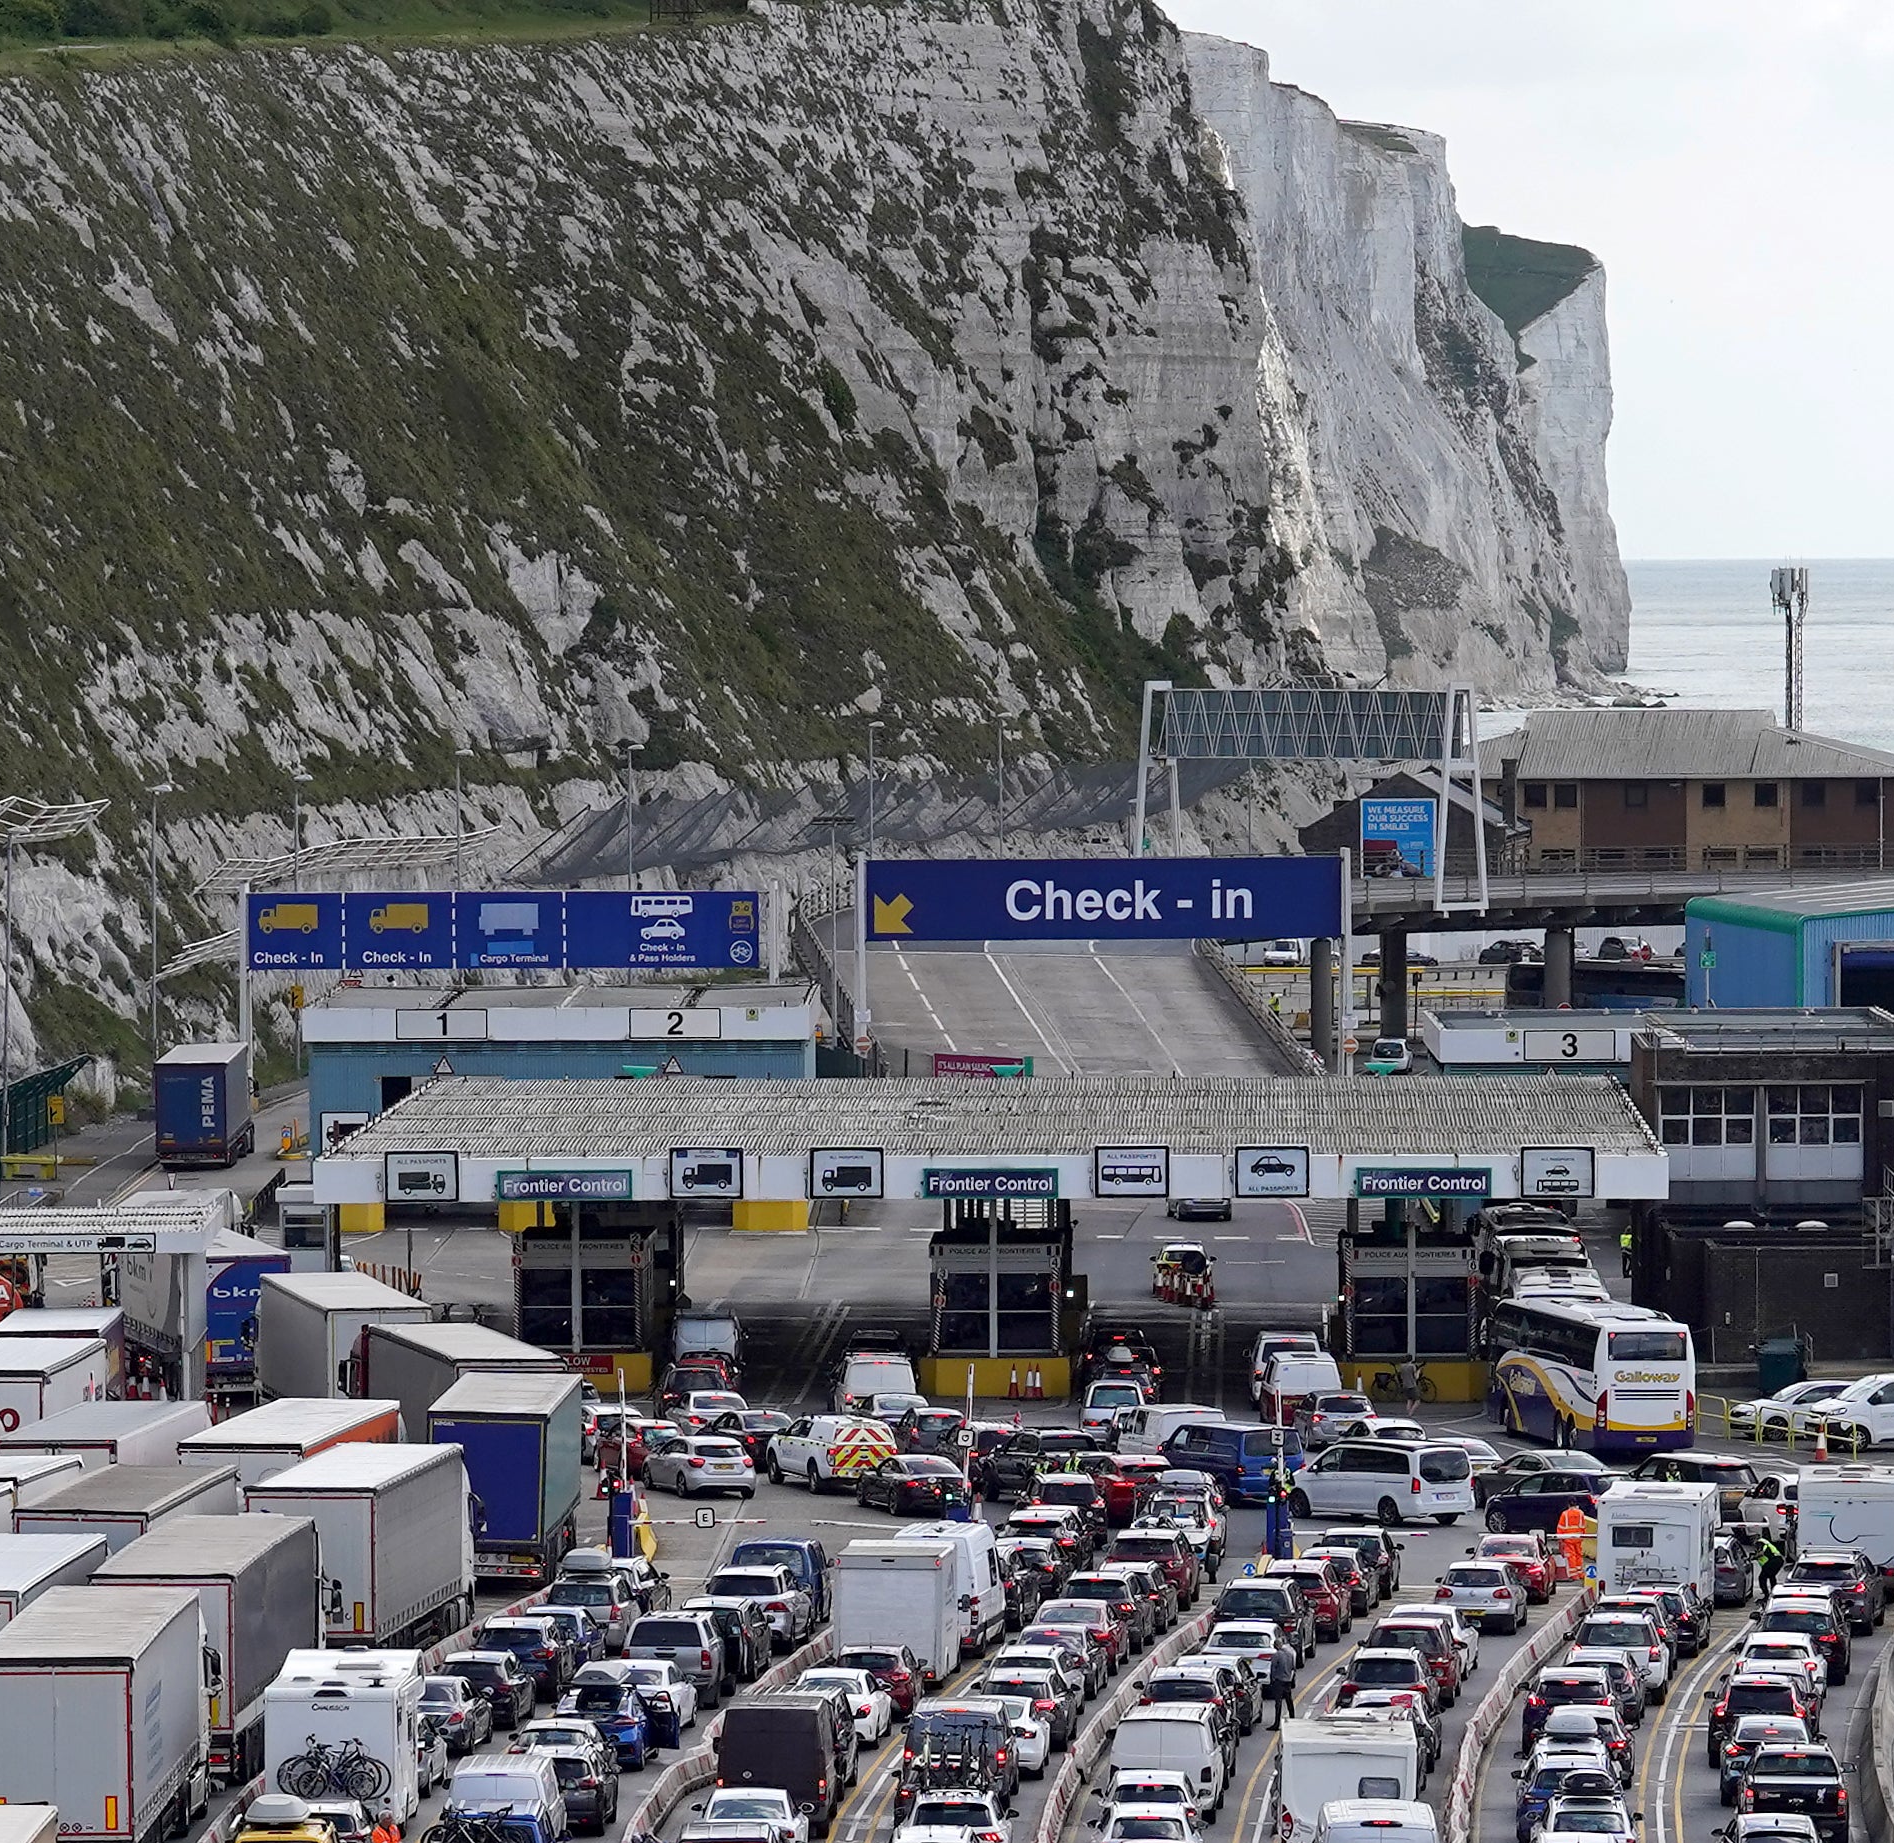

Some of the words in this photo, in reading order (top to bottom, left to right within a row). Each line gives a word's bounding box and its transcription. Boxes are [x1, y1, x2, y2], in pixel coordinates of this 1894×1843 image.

[1005, 879, 1163, 920] Check
[1211, 880, 1253, 920] in
[640, 943, 668, 951] Check
[679, 943, 686, 951] In
[254, 951, 297, 964] Check
[312, 952, 323, 964] In
[362, 951, 409, 964] Check
[420, 952, 432, 964] In
[480, 953, 506, 965] Cargo
[509, 953, 548, 963] Terminal
[638, 954, 658, 962] Pass
[659, 954, 696, 962] Holders
[437, 1013, 447, 1036] 1
[667, 1012, 684, 1035] 2
[1561, 1032, 1579, 1057] 3
[200, 1076, 215, 1128] PEMA
[503, 1178, 566, 1194] Frontier
[569, 1177, 628, 1193] Control
[930, 1177, 994, 1192] Frontier
[997, 1176, 1053, 1191] Control
[1362, 1175, 1424, 1191] Frontier
[1428, 1175, 1487, 1190] Control
[0, 1239, 25, 1250] Cargo
[27, 1239, 60, 1248] Terminal
[64, 1239, 72, 1248] &
[75, 1239, 93, 1248] UTP
[949, 1247, 976, 1255] POLICE
[1614, 1370, 1681, 1383] Galloway
